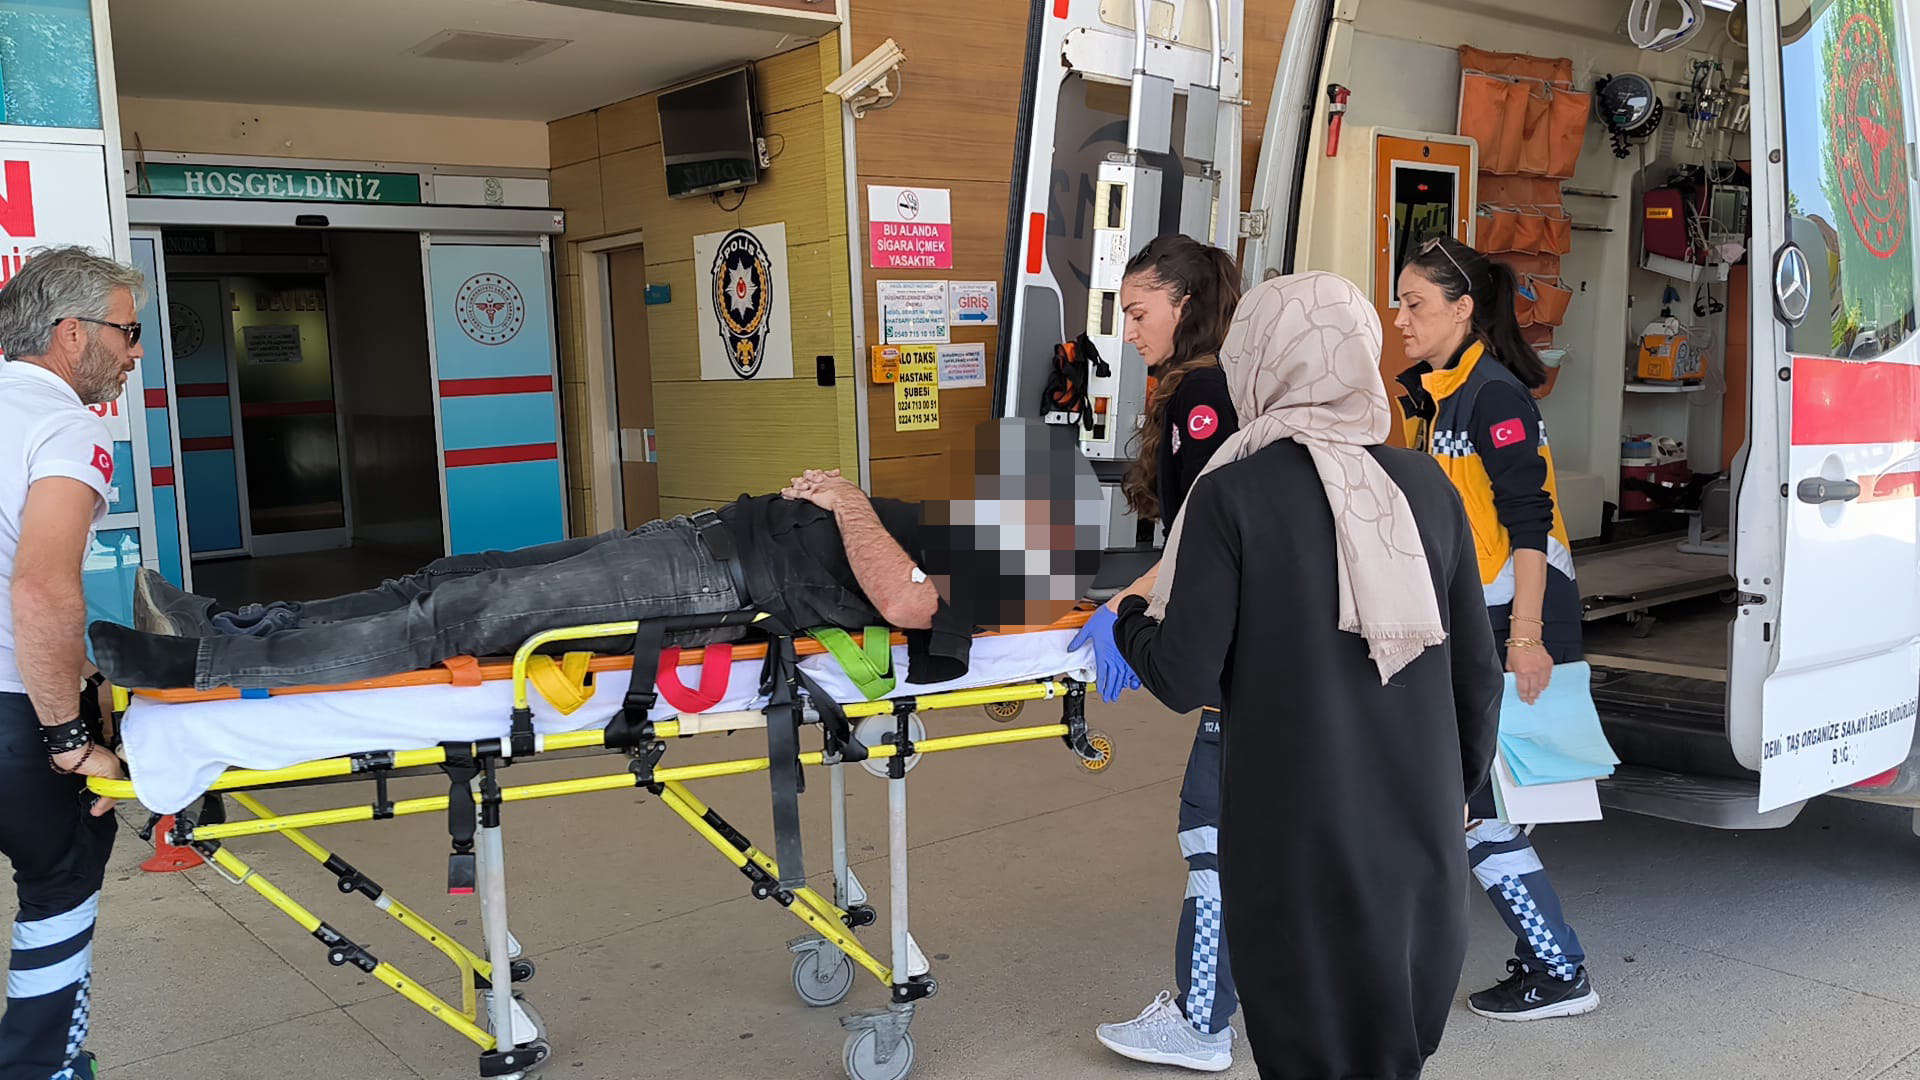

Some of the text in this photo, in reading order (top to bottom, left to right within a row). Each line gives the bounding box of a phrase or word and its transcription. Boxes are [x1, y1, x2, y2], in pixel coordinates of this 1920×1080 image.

[184, 171, 381, 200] HOŞGELDİNİZ
[883, 224, 938, 237] BU ALANDA
[877, 237, 945, 254] SİGARA İÇMEK
[888, 255, 936, 266] YASAKTIR
[958, 293, 989, 311] GİRİŞ
[899, 372, 933, 383] HASTANE
[898, 402, 911, 411] 0224
[912, 401, 922, 410] 713
[922, 401, 930, 410] 00
[898, 416, 912, 424] 0224
[930, 414, 938, 422] 34
[1801, 721, 1840, 748] ORGANİZE
